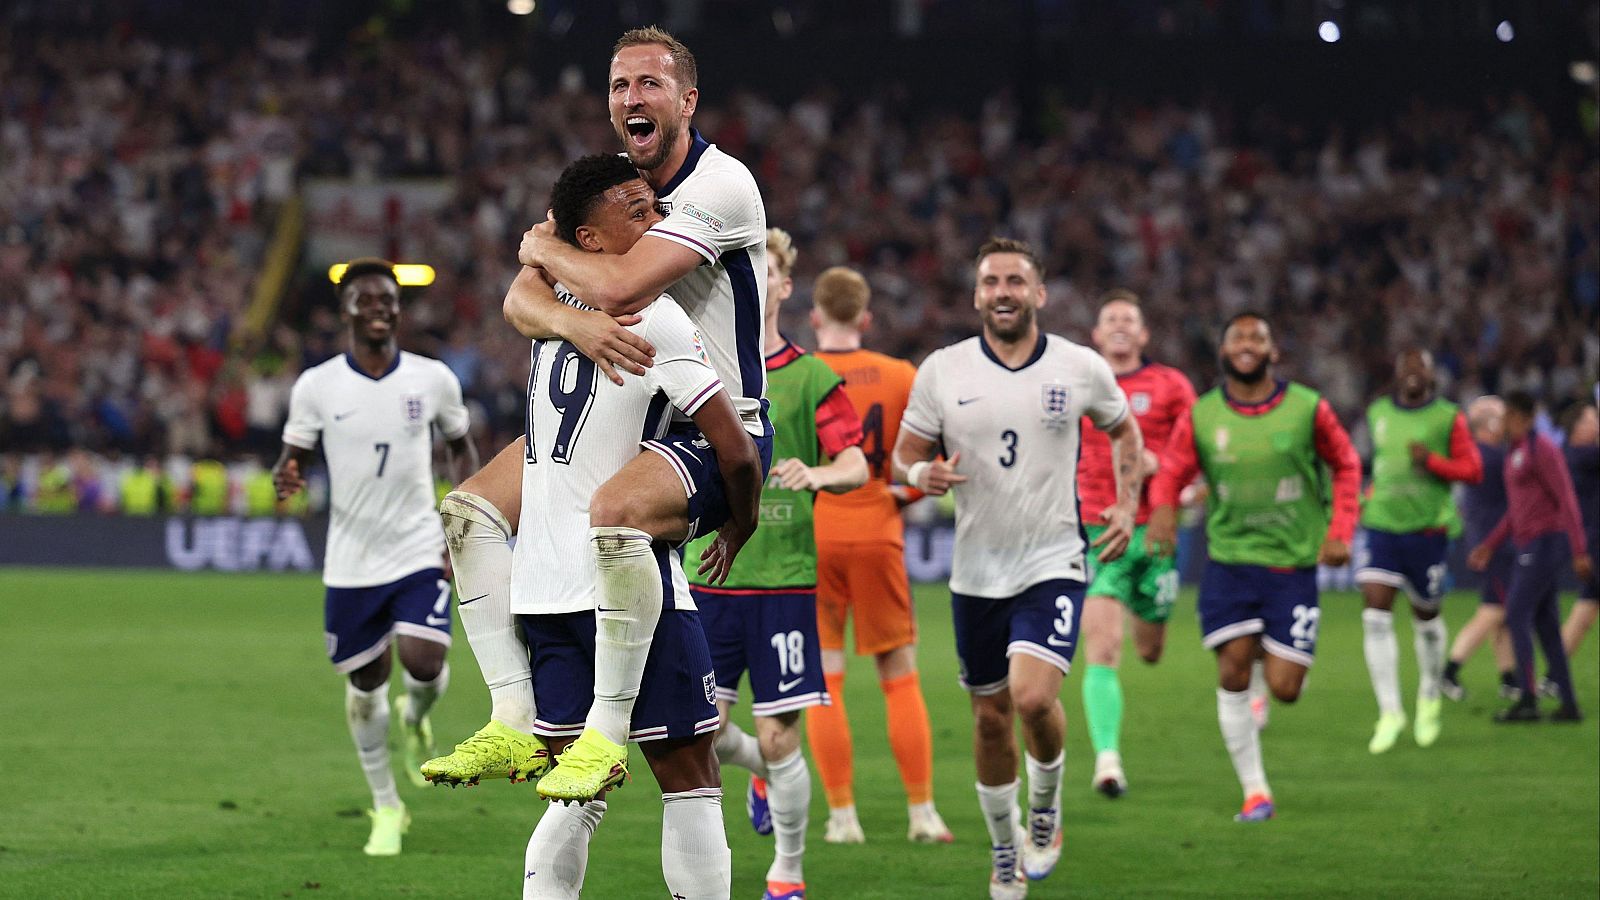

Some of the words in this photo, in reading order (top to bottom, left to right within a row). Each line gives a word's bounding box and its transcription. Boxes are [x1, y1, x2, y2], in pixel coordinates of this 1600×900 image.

[682, 206, 724, 230] FOUNDATION
[525, 339, 599, 466] 19
[375, 443, 390, 477] 7
[860, 403, 884, 479] 4
[999, 430, 1018, 468] 3
[165, 517, 314, 572] UEFA
[433, 579, 451, 614] 7
[1053, 595, 1074, 635] 3
[1290, 604, 1321, 640] 22
[771, 629, 805, 674] 18
